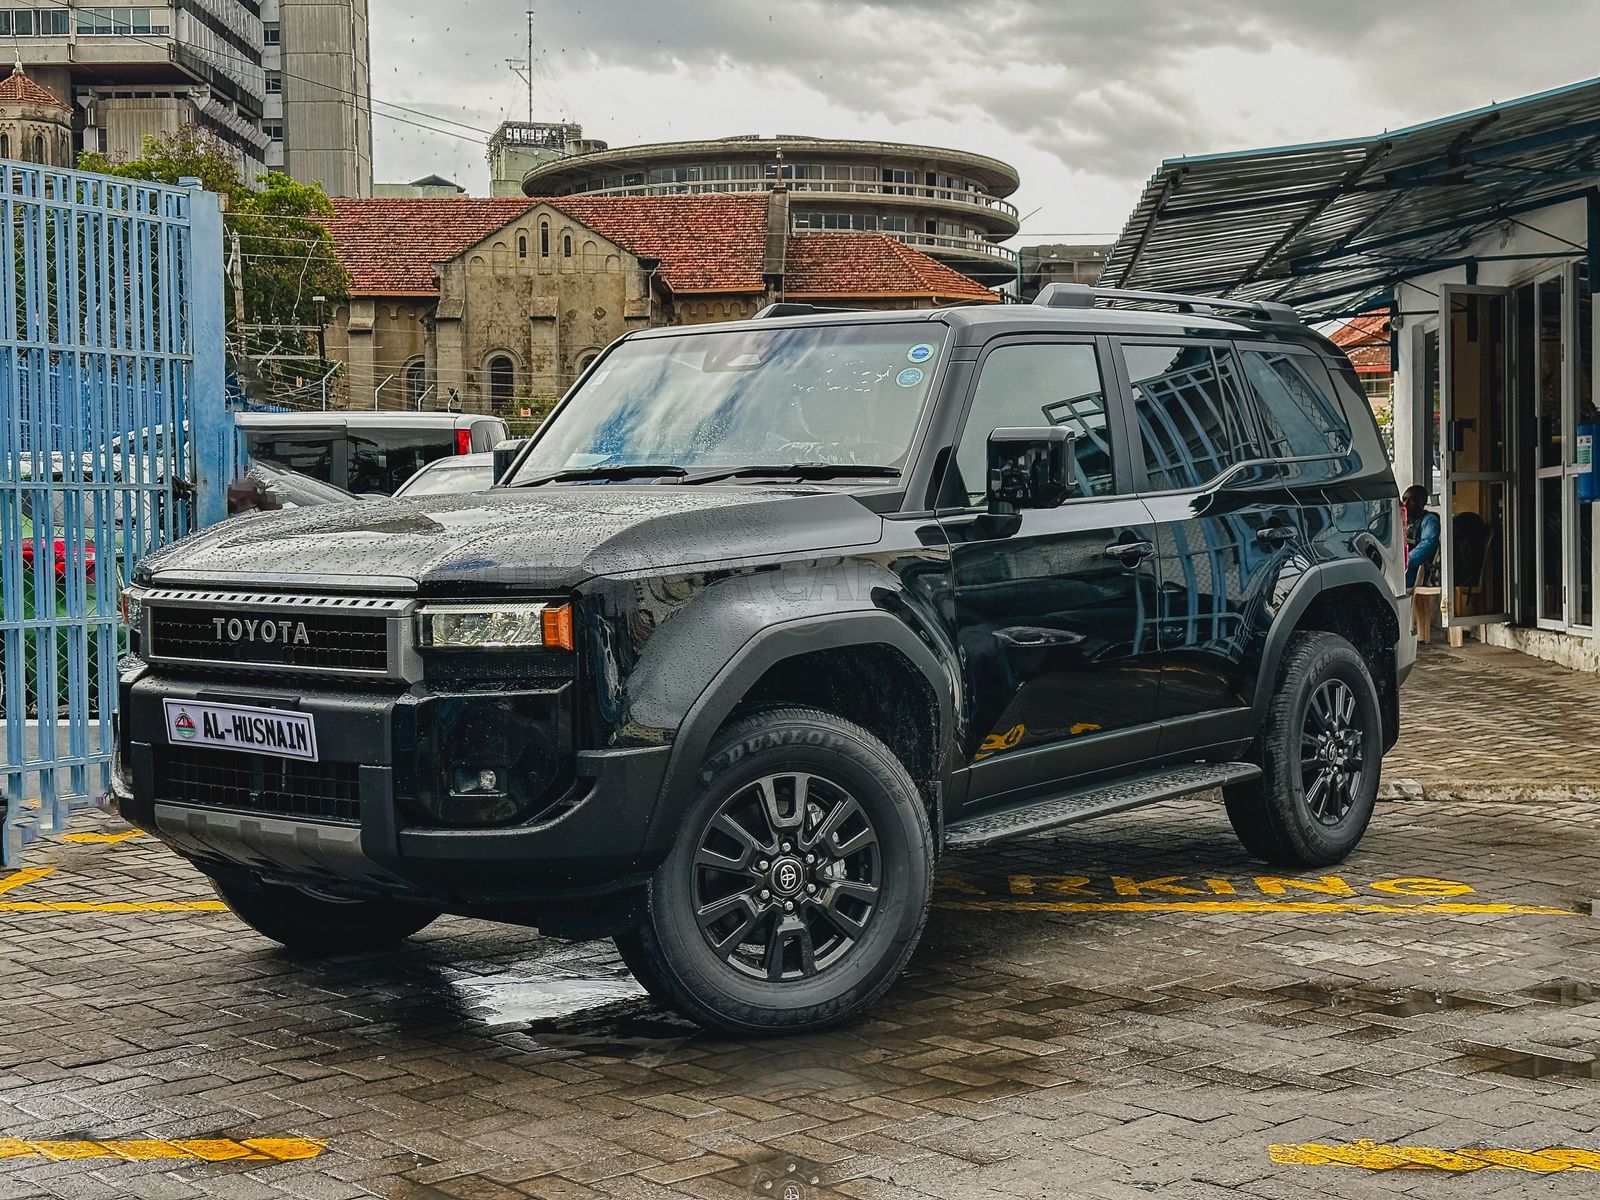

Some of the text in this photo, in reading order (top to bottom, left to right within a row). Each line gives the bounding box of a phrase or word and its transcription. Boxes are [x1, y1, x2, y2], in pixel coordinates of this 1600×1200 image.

[213, 618, 309, 644] TOYOTA
[203, 711, 308, 750] AL-HUSNAIN
[723, 729, 846, 767] DUNLOP
[934, 875, 1476, 897] ARKING
